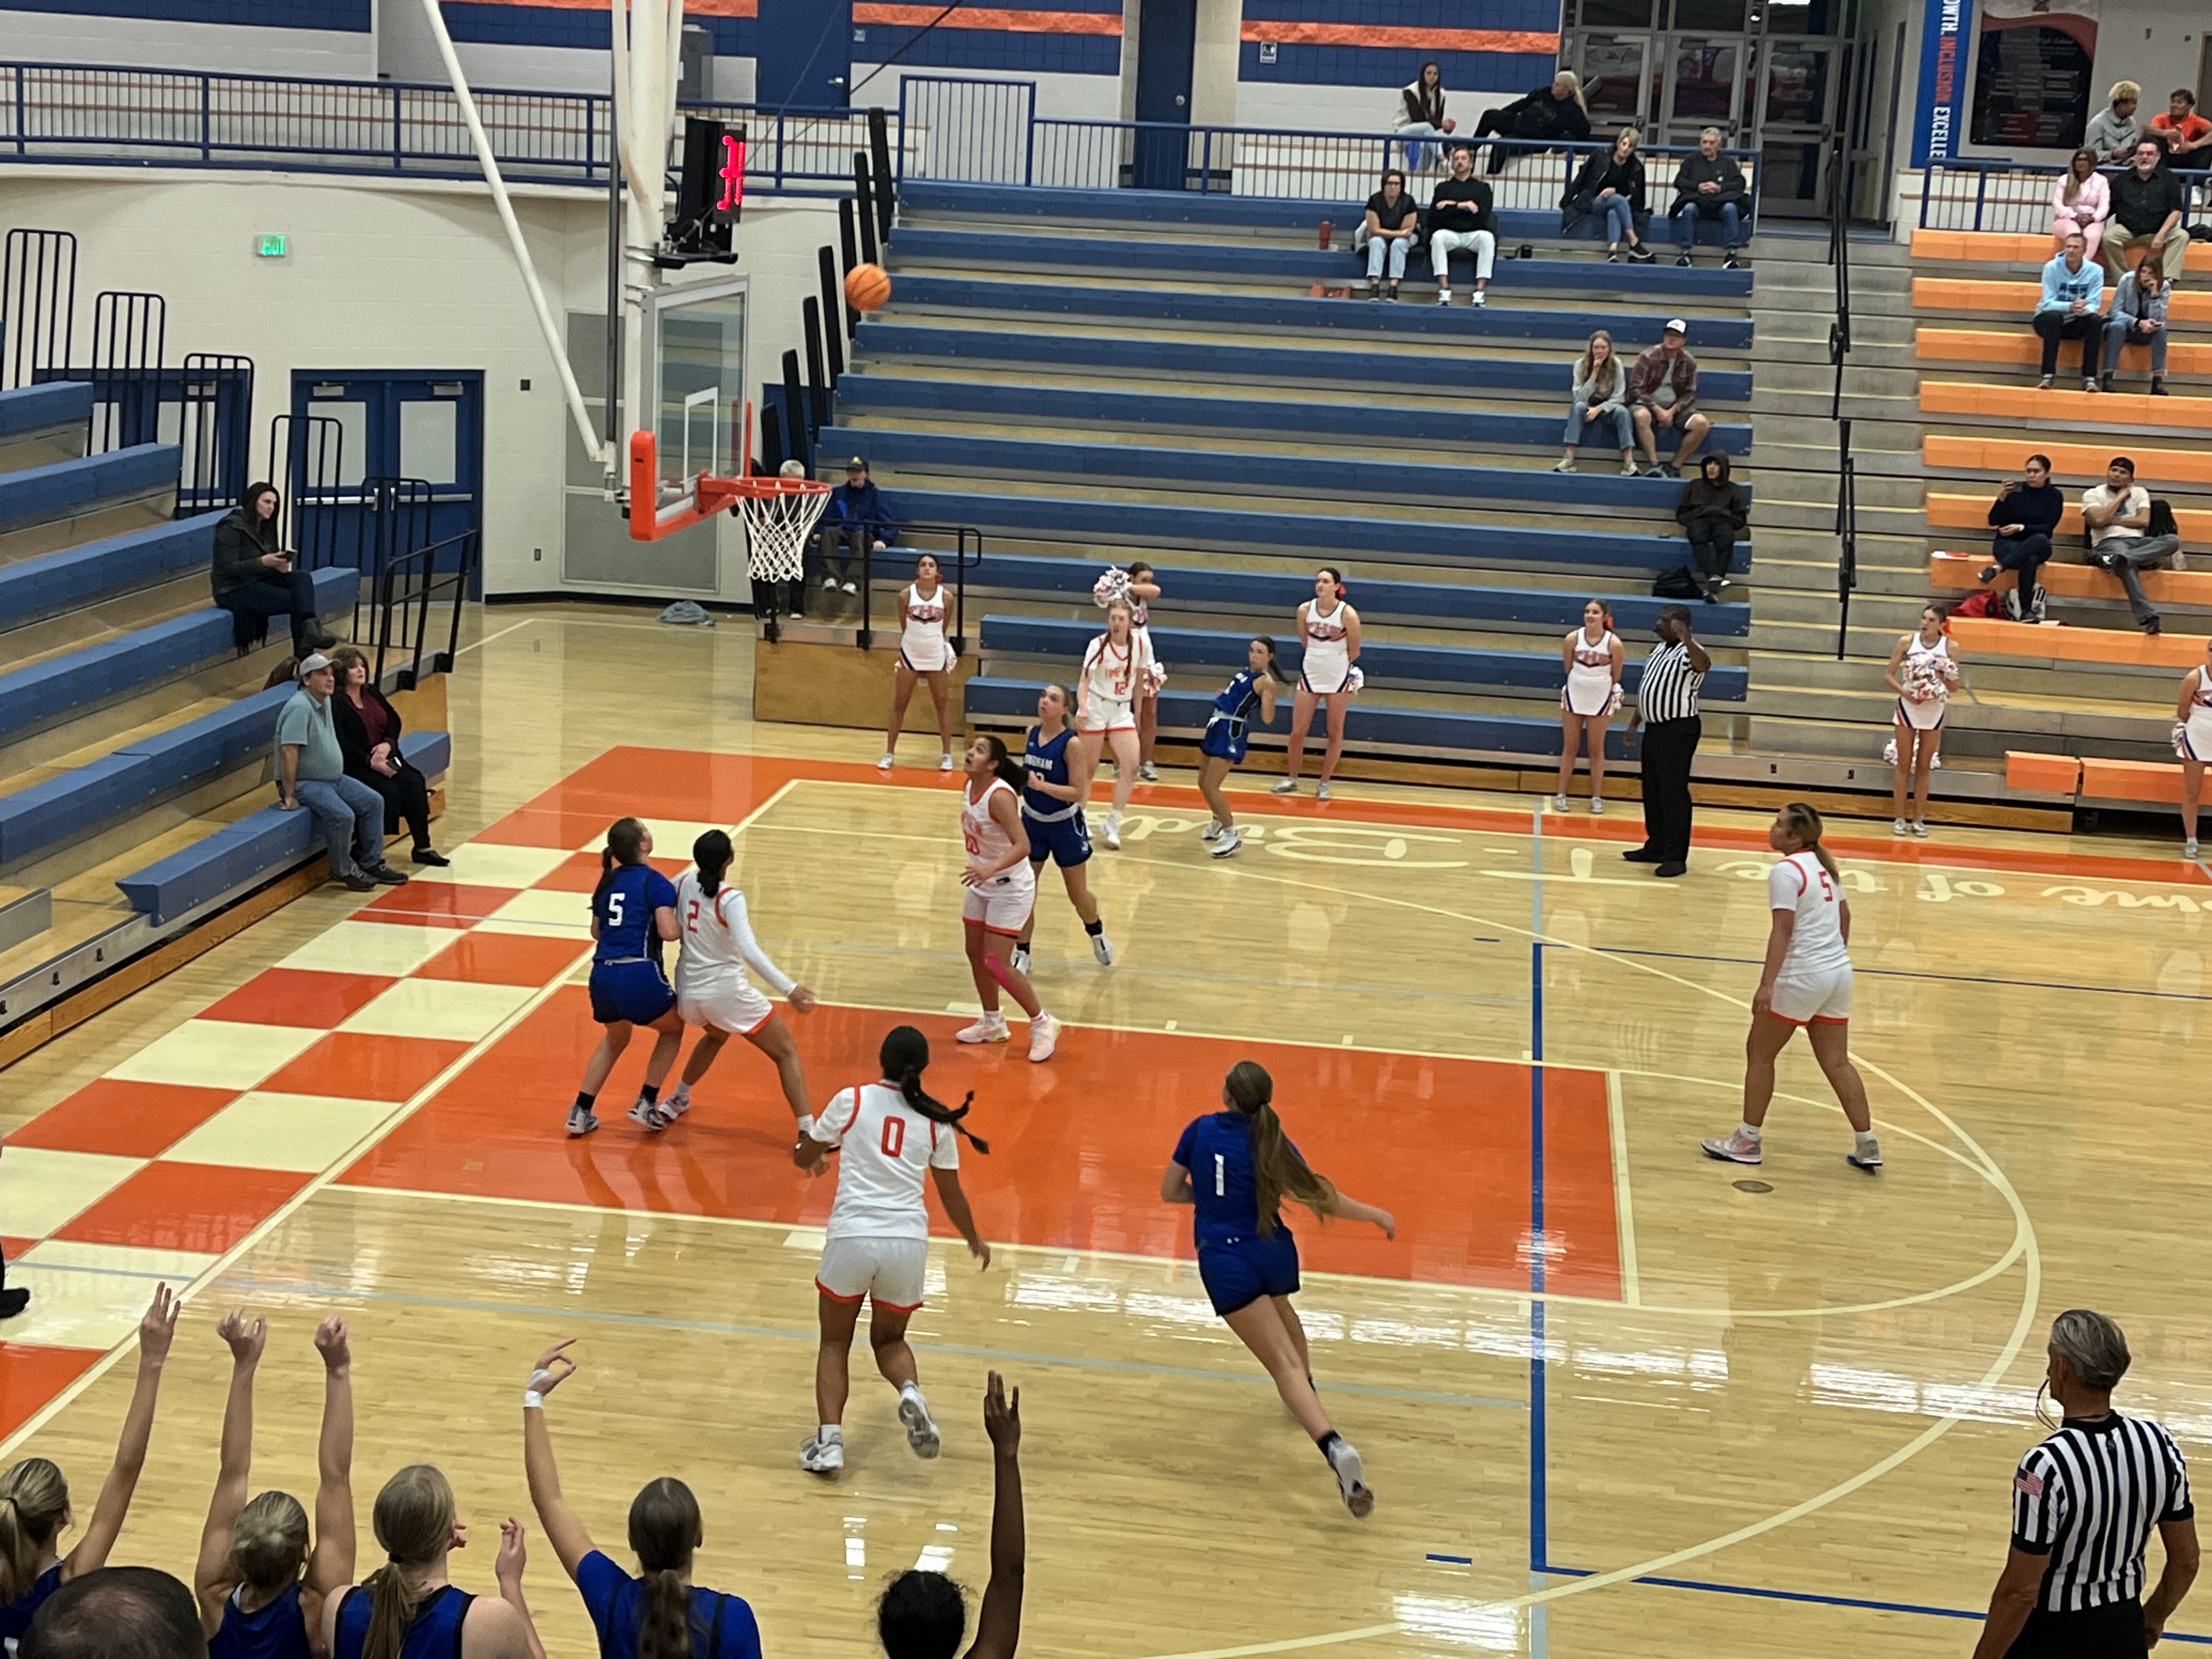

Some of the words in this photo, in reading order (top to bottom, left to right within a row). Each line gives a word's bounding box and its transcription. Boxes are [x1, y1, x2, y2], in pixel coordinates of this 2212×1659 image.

[1929, 106, 1951, 159] EXCELLE
[1715, 860, 1889, 893] te
[1818, 870, 1833, 902] 5
[1916, 873, 2006, 902] of
[608, 893, 625, 927] 5
[2041, 885, 2212, 913] me
[687, 900, 699, 934] 2
[881, 1115, 905, 1158] 0
[1214, 1153, 1225, 1197] 1
